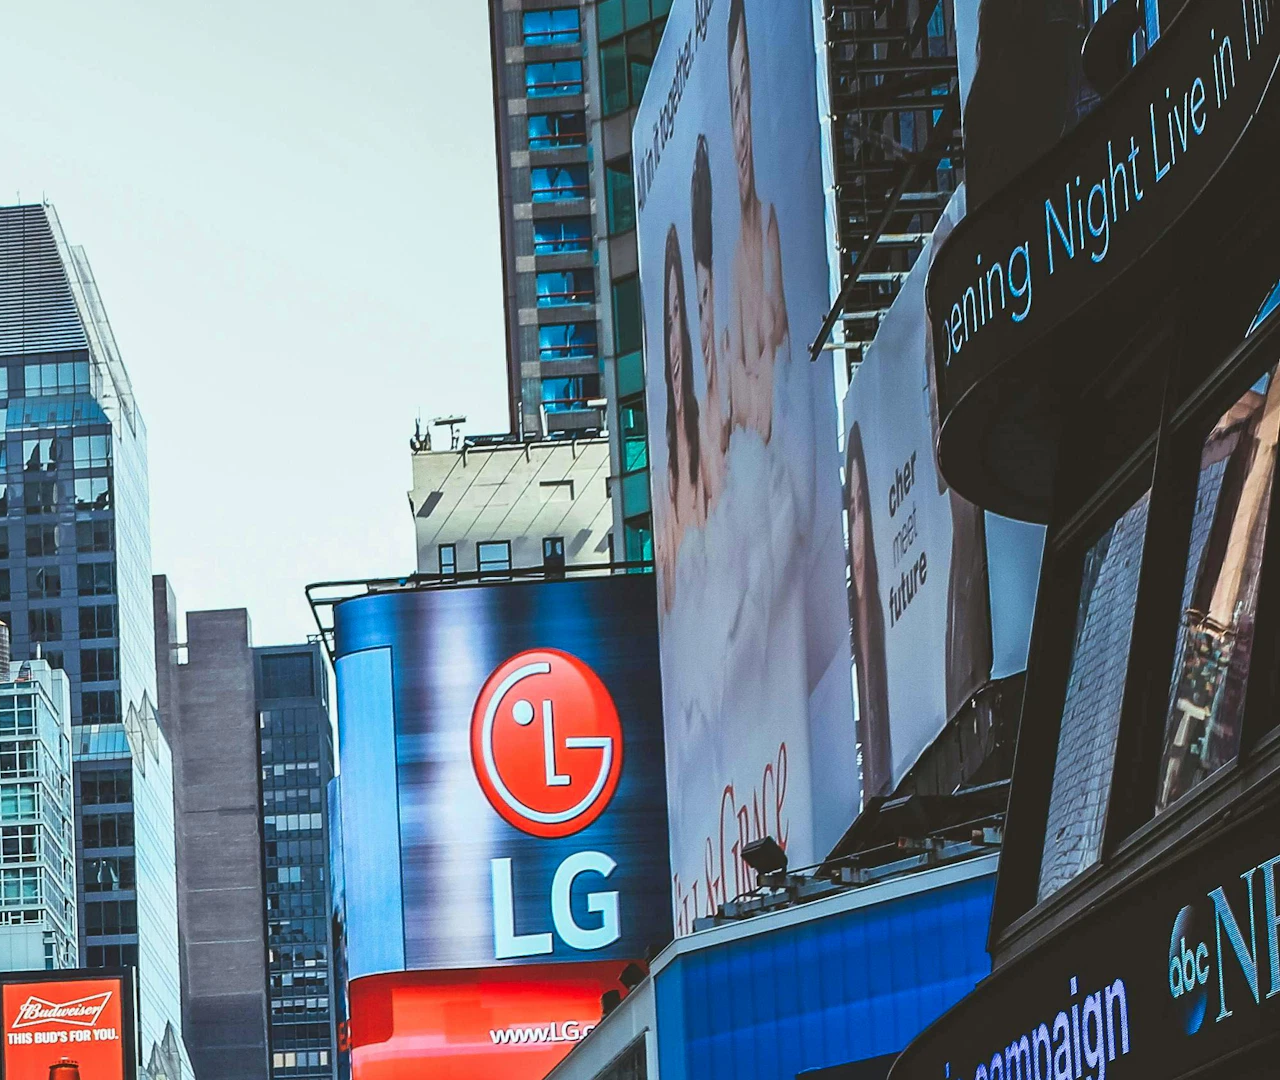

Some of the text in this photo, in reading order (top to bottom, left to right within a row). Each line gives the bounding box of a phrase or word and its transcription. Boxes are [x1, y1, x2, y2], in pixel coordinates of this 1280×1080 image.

[1044, 136, 1144, 275] Night
[1150, 77, 1207, 183] Live
[1210, 28, 1236, 109] in
[888, 448, 918, 518] cher
[891, 504, 919, 567] meet
[888, 550, 929, 630] future
[490, 850, 623, 961] LG
[1169, 937, 1211, 999] abc
[7, 1029, 120, 1045] THIS BUD'S FOR YOU.
[22, 1002, 103, 1023] Budweiser
